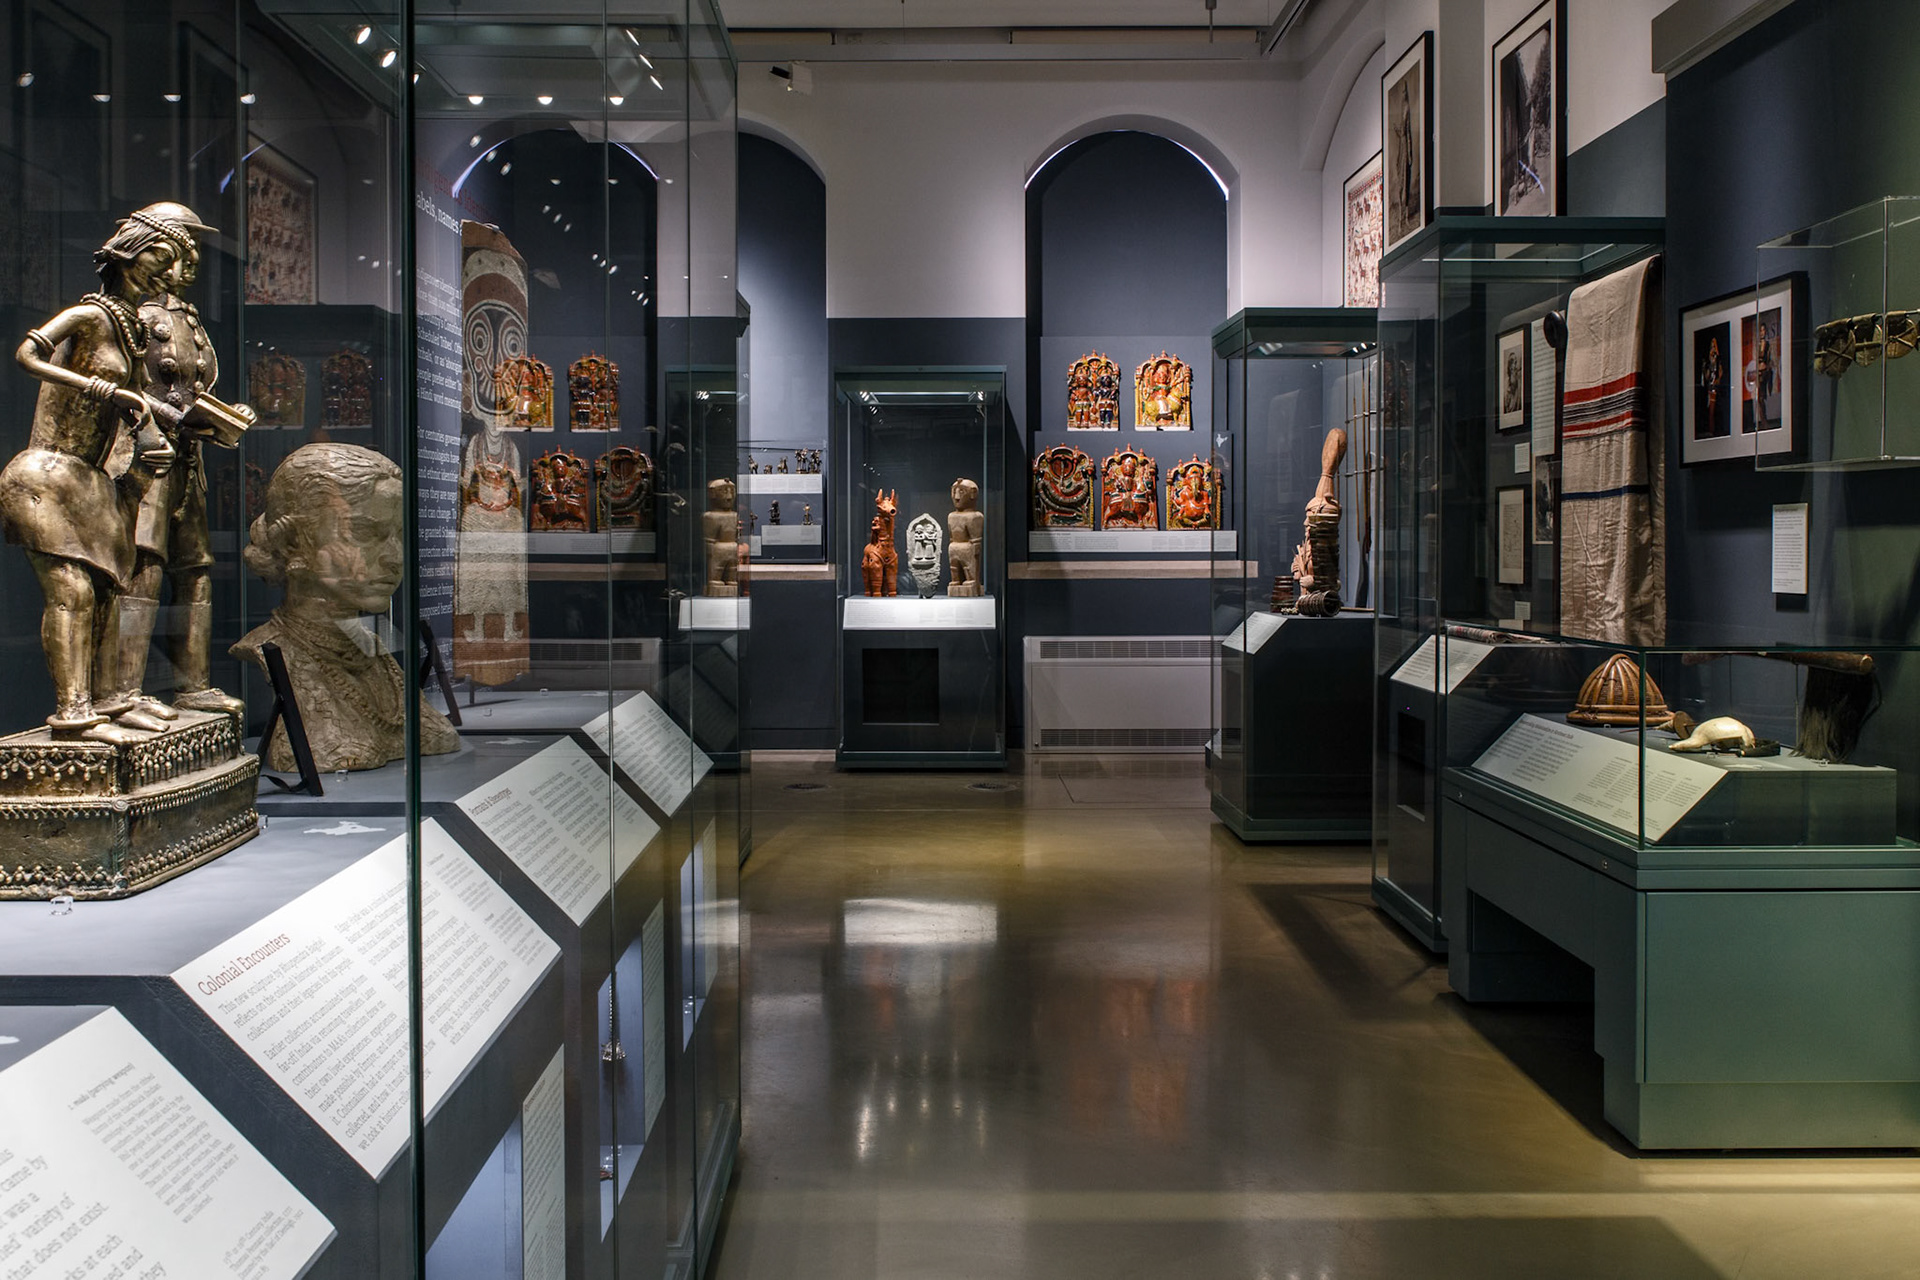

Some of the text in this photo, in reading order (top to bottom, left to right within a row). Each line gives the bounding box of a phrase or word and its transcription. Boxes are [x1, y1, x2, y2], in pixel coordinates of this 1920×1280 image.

[416, 191, 436, 222] abels,
[437, 207, 458, 234] names
[195, 933, 291, 997] Colonial Encounters
[291, 964, 318, 983] histories
[314, 956, 324, 968] of
[216, 999, 238, 1015] This
[233, 991, 250, 1005] new
[246, 973, 276, 996] sculpture
[269, 967, 286, 978] by
[260, 994, 277, 1006] the
[273, 976, 298, 999] colonial
[233, 1006, 259, 1029] reflects
[246, 1013, 280, 1042] collections
[276, 1002, 291, 1018] and
[284, 994, 304, 1010] their
[297, 980, 323, 1000] legacies
[316, 974, 331, 985] for
[324, 968, 338, 979] his
[255, 1001, 267, 1012] on
[261, 973, 368, 1060] Earlier collectors accumulated things from
[274, 1050, 300, 1073] far-off
[292, 1041, 313, 1058] India
[309, 1034, 322, 1046] via
[317, 1015, 346, 1039] returning
[359, 986, 377, 1001] Later
[291, 1053, 327, 1086] contributors
[320, 1047, 333, 1057] to
[343, 1014, 369, 1038] collection
[362, 1004, 380, 1019] drew
[376, 999, 386, 1009] on
[301, 1081, 322, 1099] their
[317, 1071, 333, 1087] own
[326, 1057, 345, 1076] lived
[368, 1011, 397, 1038] experiences
[377, 1051, 399, 1074] impact
[395, 1047, 406, 1058] on
[317, 1093, 337, 1113] made
[332, 1073, 357, 1100] possible
[349, 1067, 365, 1078] by
[375, 1039, 388, 1055] and
[362, 1073, 378, 1090] had
[374, 1069, 385, 1080] an
[383, 1080, 395, 1092] it
[390, 1068, 406, 1088] must
[334, 1085, 369, 1119] Colonialism
[367, 1096, 381, 1114] and
[373, 1088, 391, 1103] how
[357, 1101, 402, 1152] we look at historic
[0, 1164, 33, 1192] came
[25, 1151, 51, 1174] by
[3, 1191, 40, 1221] was a
[17, 1191, 76, 1245] variety of
[28, 1234, 63, 1265] does
[56, 1219, 83, 1243] not
[74, 1196, 109, 1227] exist.
[90, 1229, 124, 1260] each
[81, 1253, 100, 1271] at
[116, 1244, 144, 1271] and
